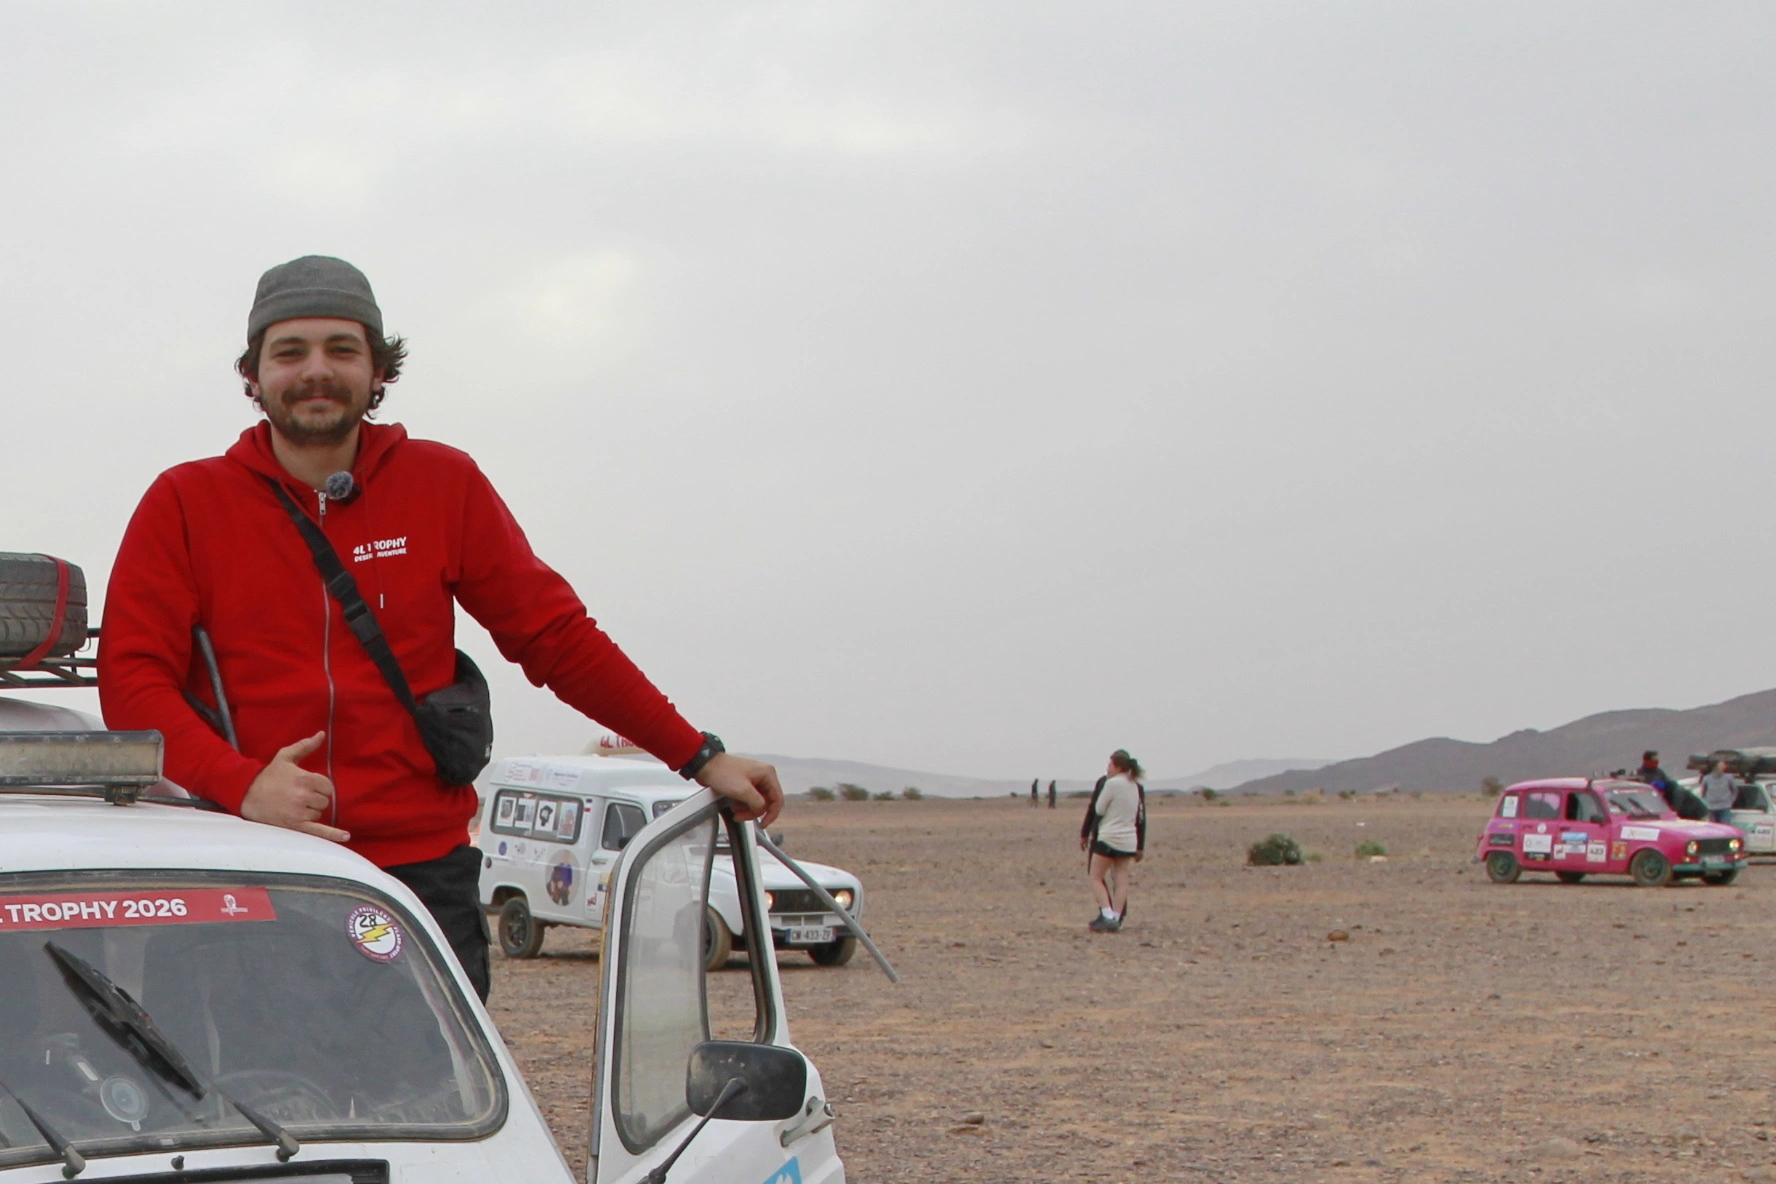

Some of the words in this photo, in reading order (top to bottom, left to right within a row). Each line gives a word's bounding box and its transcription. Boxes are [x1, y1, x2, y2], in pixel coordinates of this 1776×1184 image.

[4, 899, 118, 922] TROPHY
[122, 898, 189, 918] 2026
[359, 914, 378, 927] 28
